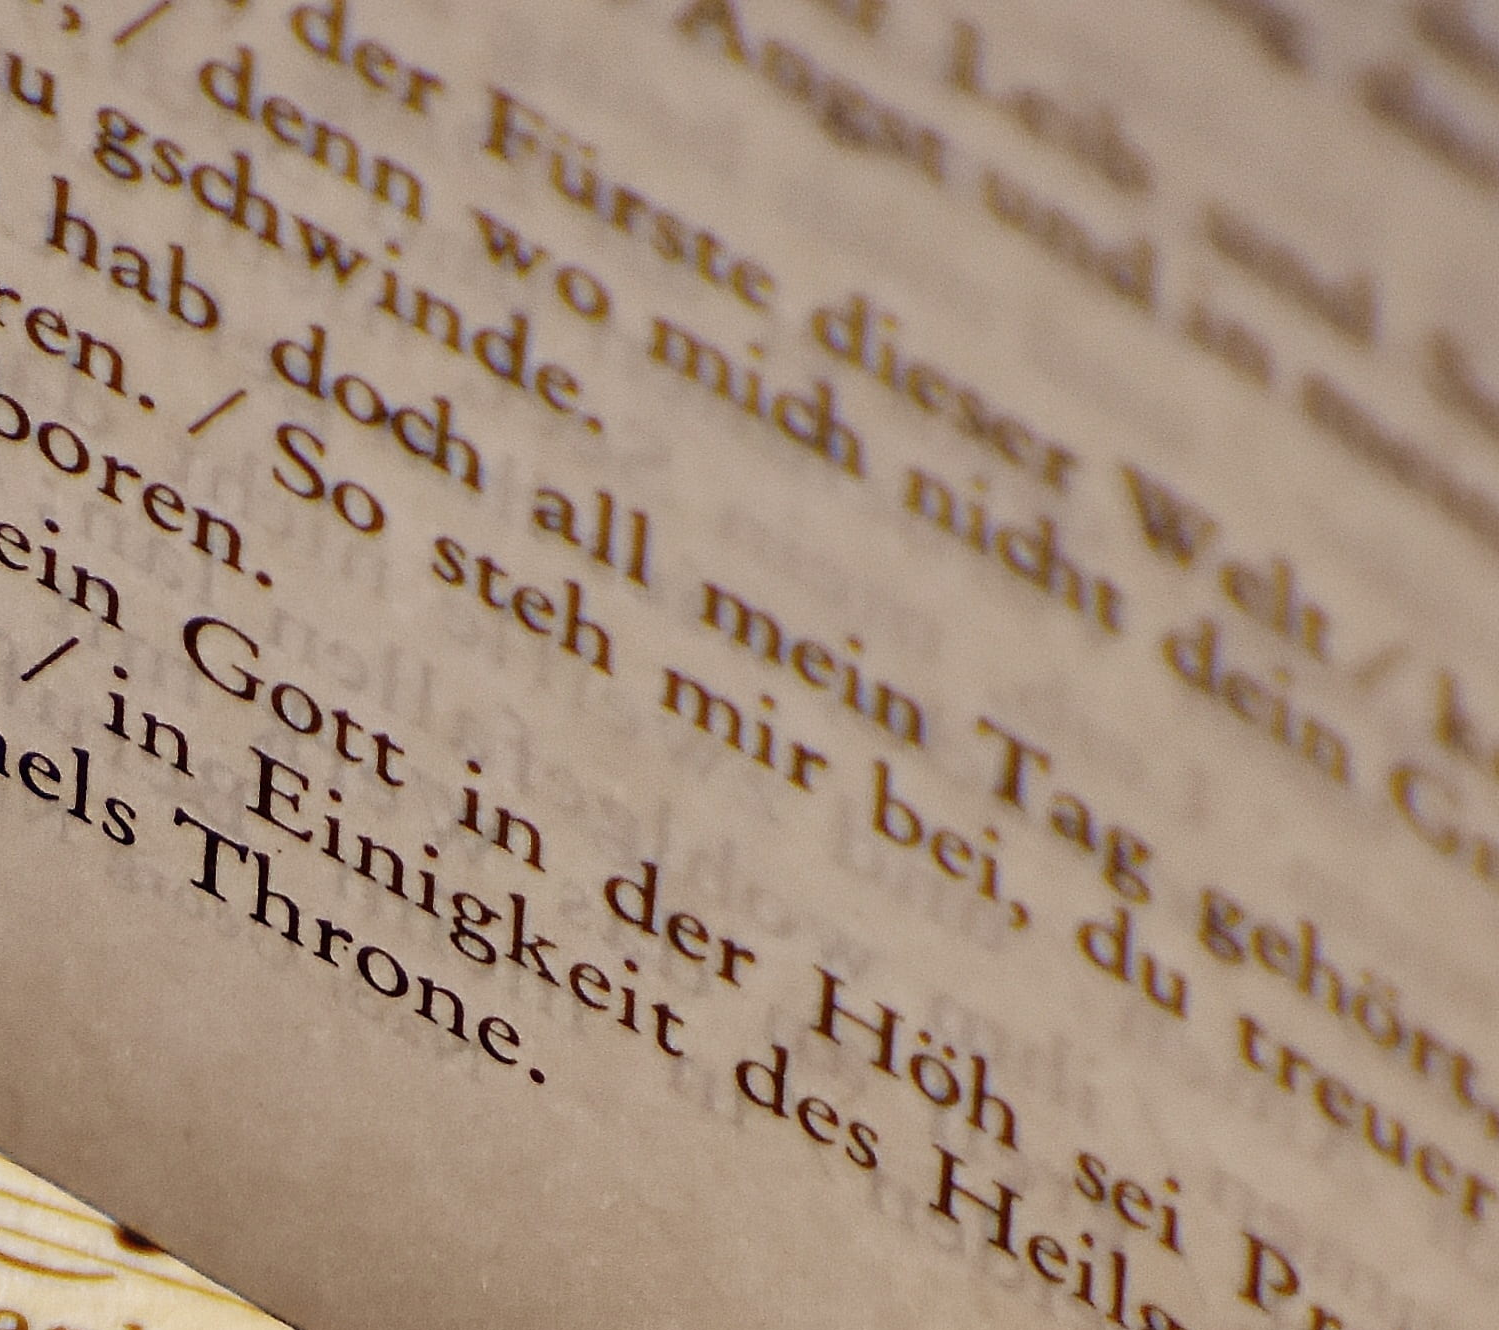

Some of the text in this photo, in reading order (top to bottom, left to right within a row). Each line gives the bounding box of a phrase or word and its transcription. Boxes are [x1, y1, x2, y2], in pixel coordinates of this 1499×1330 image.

[46, 176, 220, 331] hab
[271, 325, 482, 492] doch
[532, 487, 651, 591] all
[702, 582, 930, 746] mein
[976, 717, 1152, 906] Tag
[93, 105, 603, 435] gschwinde.
[199, 44, 427, 222] denn
[470, 204, 612, 321] wo
[648, 315, 866, 478] mich
[904, 464, 1122, 636] nicht
[1161, 618, 1351, 785] dein
[289, 0, 445, 116] der
[482, 84, 776, 309] Fürste
[811, 292, 1079, 496] dieser
[1117, 461, 1332, 665] Welt
[103, 666, 194, 776] in
[245, 748, 686, 1059] Einigkeit
[736, 1047, 880, 1169] des
[173, 809, 548, 1086] Throne.
[181, 616, 408, 788] Gott
[458, 762, 547, 871] in
[605, 862, 755, 989] der
[813, 965, 1019, 1152] Höh
[1073, 1150, 1183, 1254] sei
[271, 423, 387, 536] So
[430, 534, 614, 676] steh
[660, 667, 831, 795] mir
[871, 759, 1029, 932] bei,
[1075, 906, 1191, 1022] du
[1235, 1012, 1498, 1222] treuer
